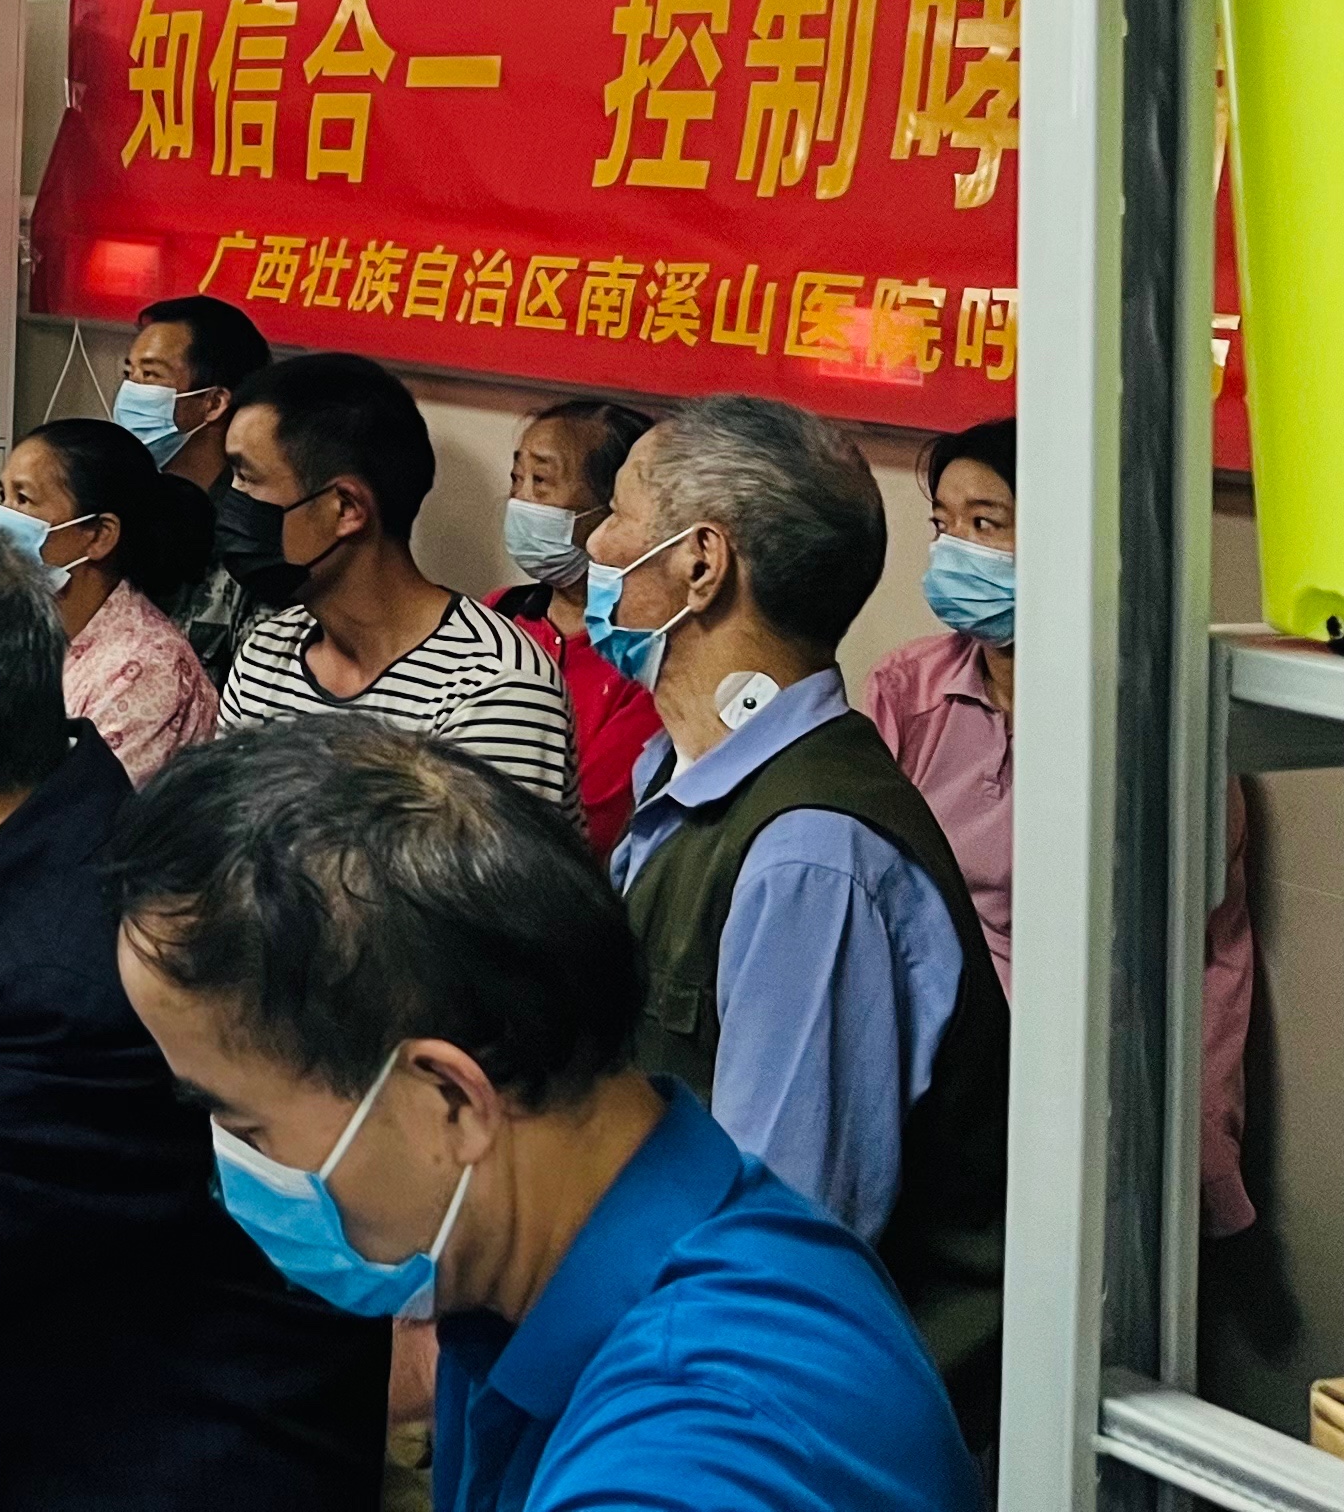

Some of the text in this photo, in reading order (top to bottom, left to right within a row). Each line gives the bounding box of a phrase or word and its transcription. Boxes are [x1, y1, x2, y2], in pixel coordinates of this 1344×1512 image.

[199, 230, 1019, 381] 广西壮族自治区南溪山医院呼
